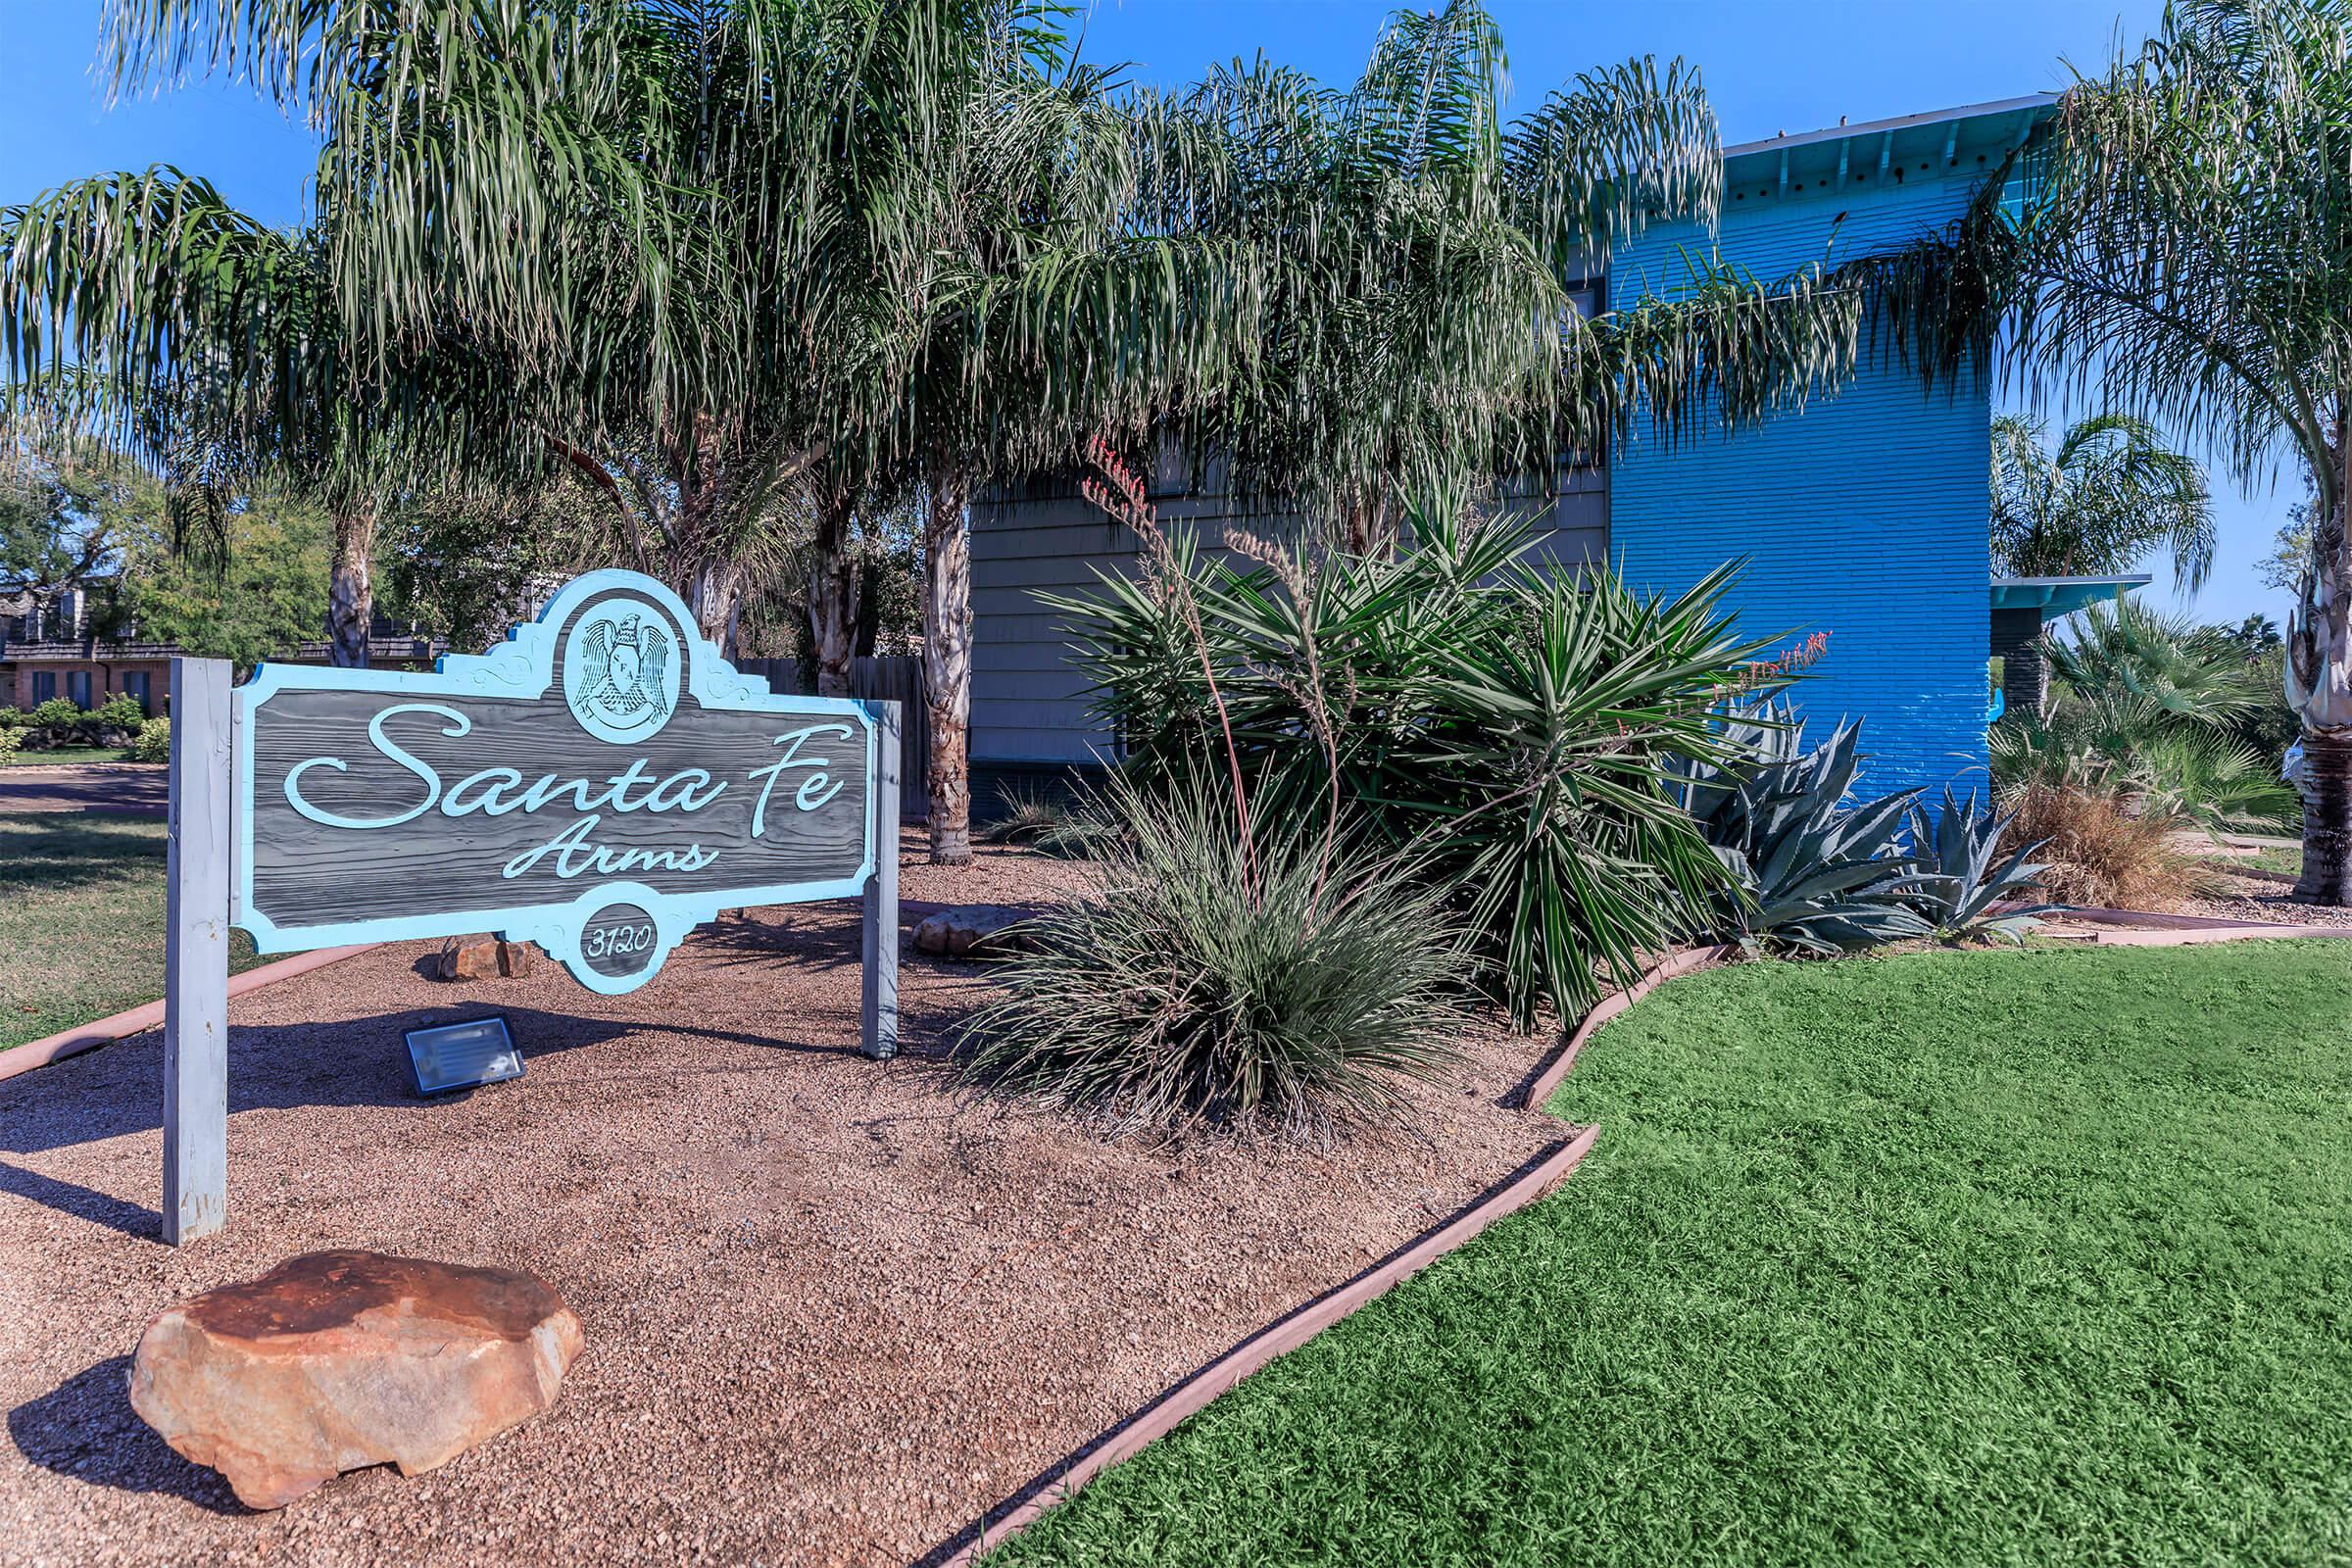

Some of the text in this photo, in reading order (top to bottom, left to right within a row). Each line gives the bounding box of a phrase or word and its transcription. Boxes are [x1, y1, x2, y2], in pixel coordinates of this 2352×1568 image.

[283, 703, 853, 838] Santa Fe
[501, 813, 719, 879] Arms
[587, 925, 652, 956] 3120
